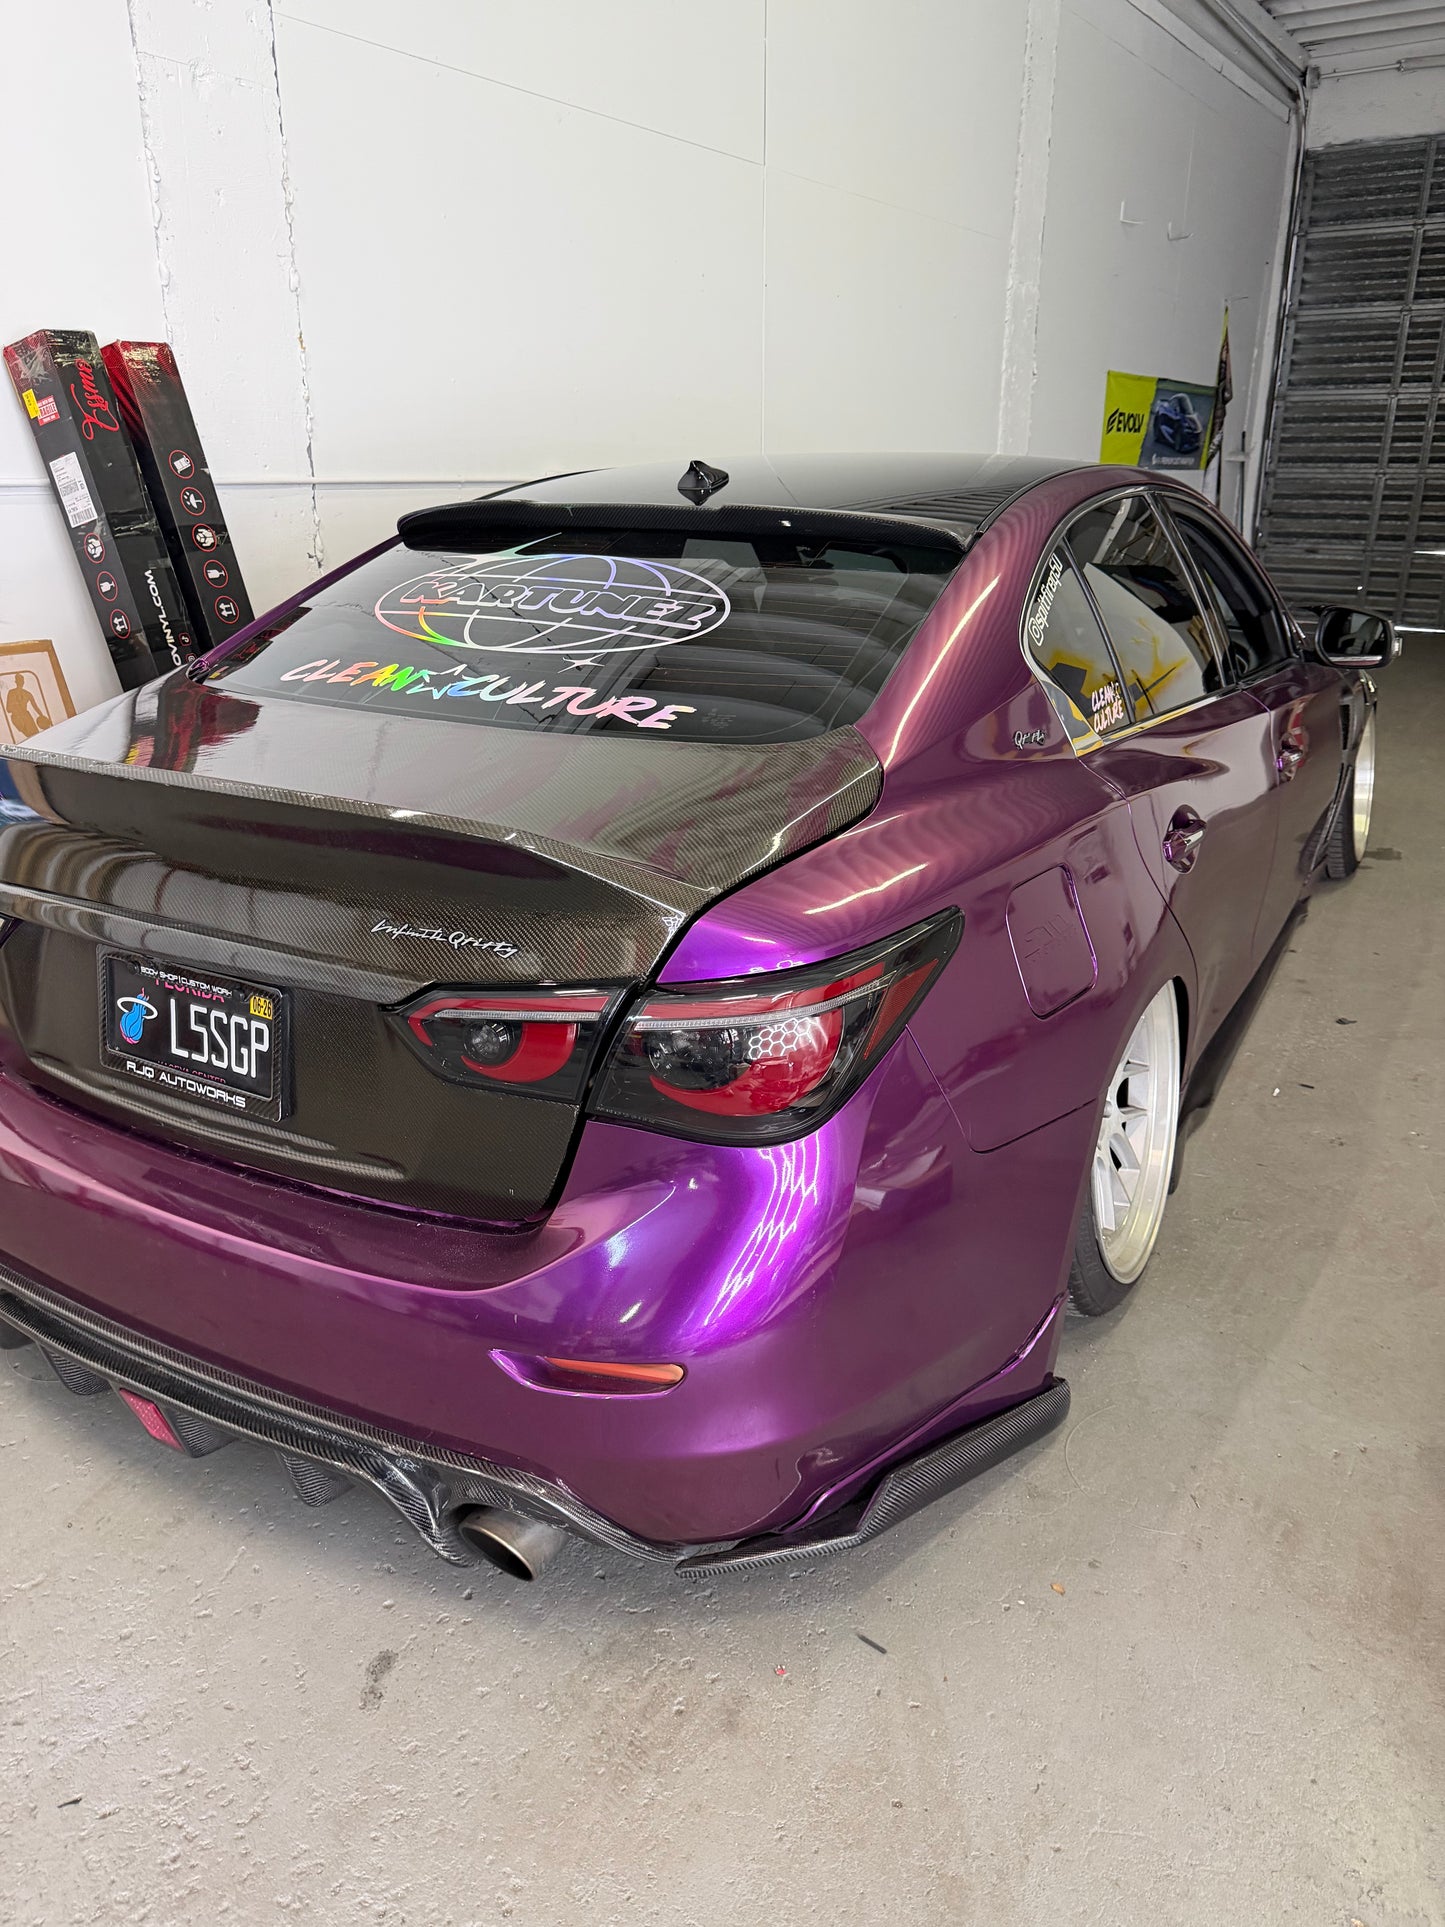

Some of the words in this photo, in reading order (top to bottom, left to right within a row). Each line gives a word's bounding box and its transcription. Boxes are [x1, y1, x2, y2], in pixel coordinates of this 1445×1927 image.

[70, 358, 119, 440] Essmo
[1116, 412, 1145, 433] EVOLV
[400, 581, 717, 630] KARTUNEZ
[279, 659, 415, 692] CLEAN
[447, 674, 697, 729] CULTURE
[140, 966, 158, 976] BODY
[211, 985, 233, 997] WORK
[170, 998, 269, 1079] L5SGP
[126, 1060, 155, 1079] RJQ
[159, 1071, 247, 1108] AUTOWORKS
